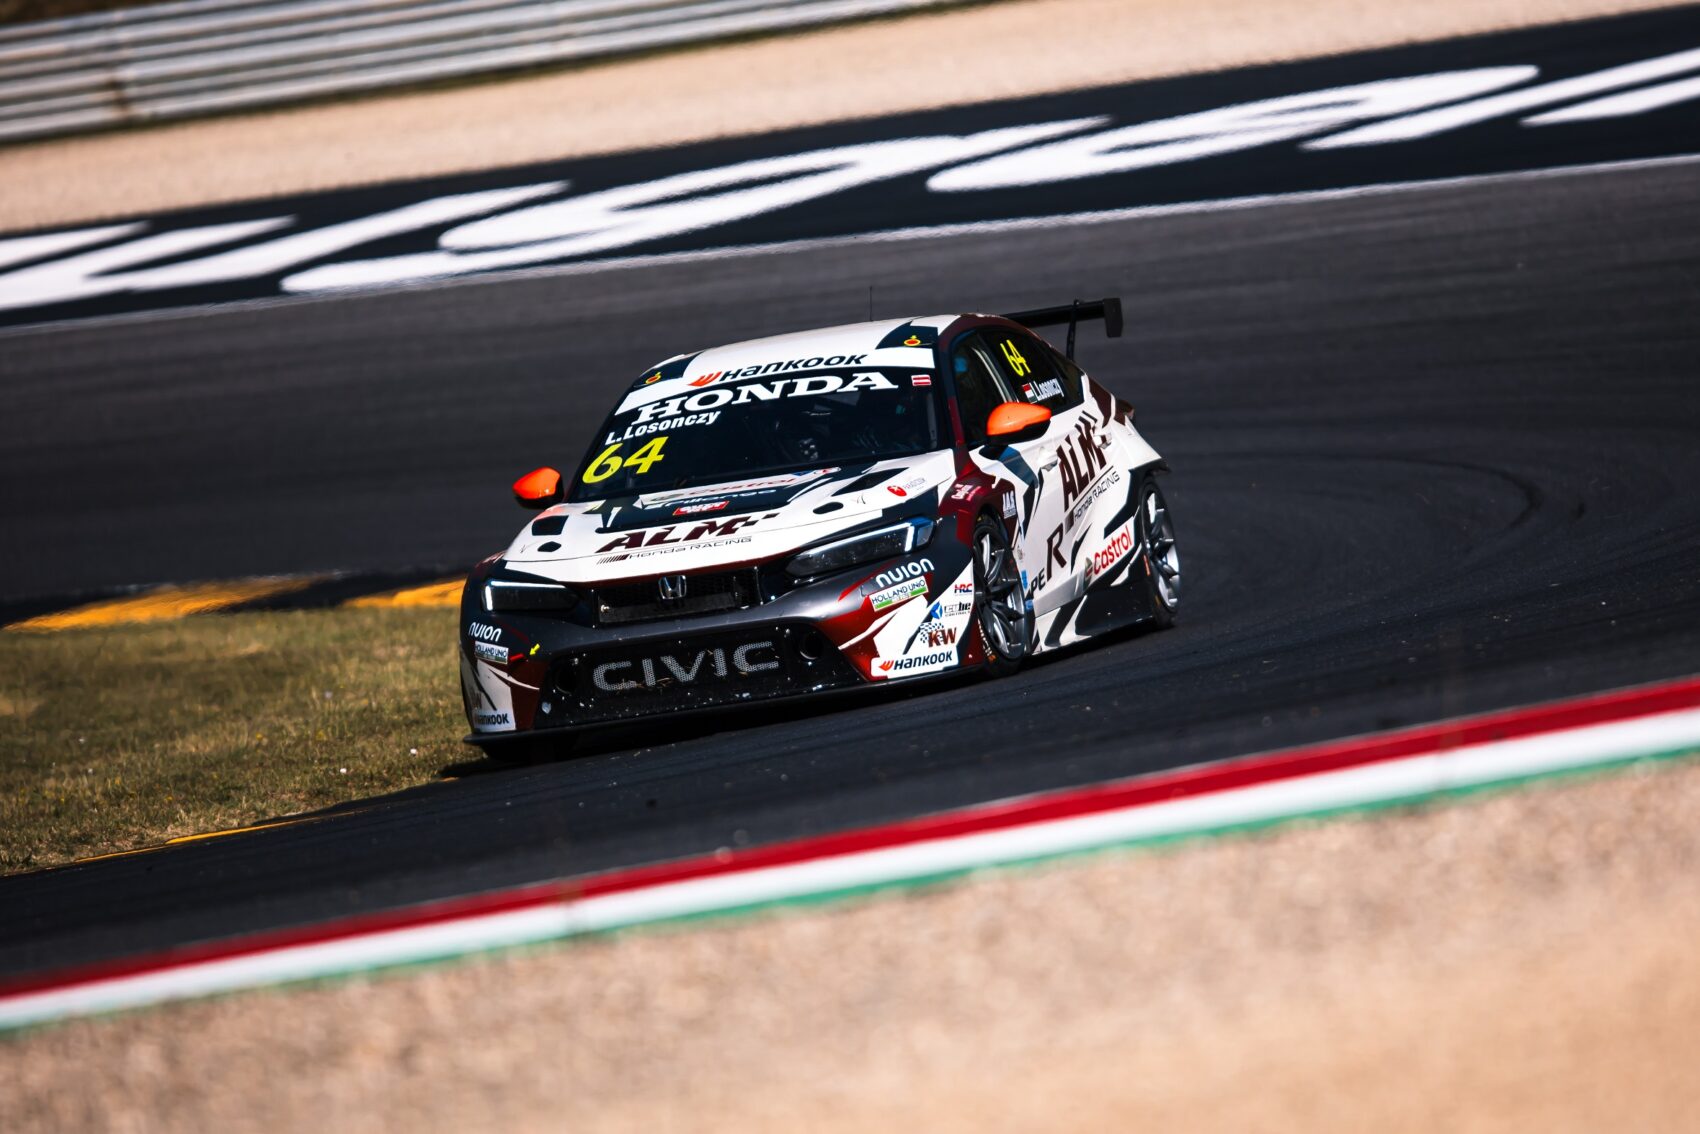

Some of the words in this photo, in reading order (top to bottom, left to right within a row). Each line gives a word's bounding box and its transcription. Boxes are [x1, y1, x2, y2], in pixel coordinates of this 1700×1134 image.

[1000, 338, 1032, 378] 64
[631, 371, 899, 426] HONDA
[582, 435, 670, 484] 64
[1056, 421, 1108, 513] ALM
[1092, 471, 1121, 500] RACING
[595, 513, 753, 554] ALM
[628, 547, 686, 560] Honda
[689, 536, 752, 550] RACING
[1046, 522, 1068, 583] R
[1093, 525, 1133, 576] Castrol
[875, 557, 935, 588] nuion
[954, 583, 973, 594] HRC
[872, 585, 908, 605] HOLLAND
[928, 627, 957, 648] KW
[593, 640, 780, 692] CIVIC
